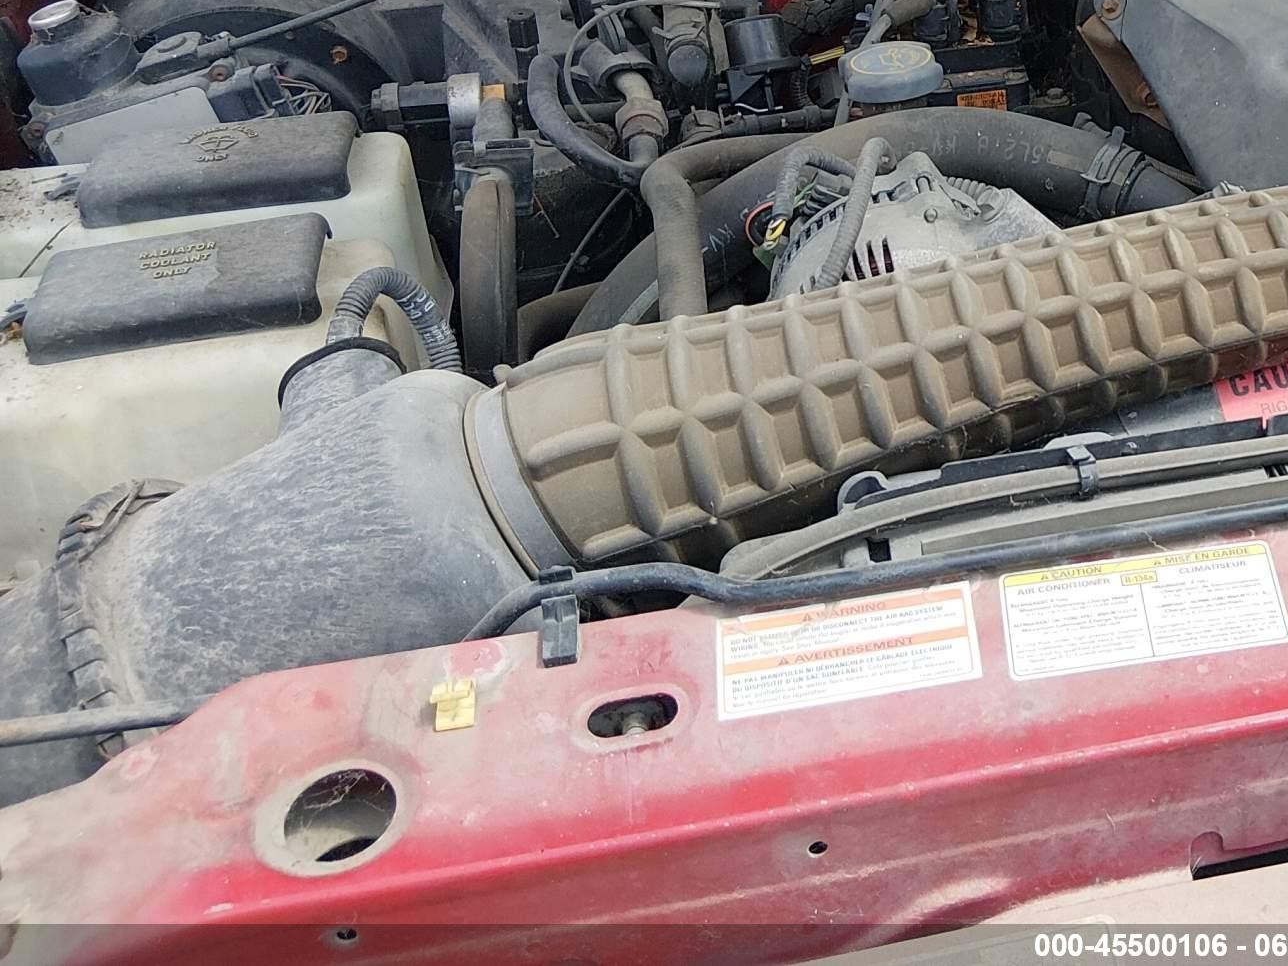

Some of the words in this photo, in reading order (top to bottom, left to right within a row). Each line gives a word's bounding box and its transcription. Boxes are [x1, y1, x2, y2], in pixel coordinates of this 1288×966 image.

[139, 241, 217, 259] RADIATOR
[140, 253, 211, 270] COOLANT
[153, 266, 192, 279] ONLY
[1163, 554, 1193, 565] MISE
[1211, 546, 1250, 558] GARDE
[1050, 565, 1103, 580] CAUTION
[1177, 559, 1247, 575] CLIMATISEUR
[1015, 586, 1036, 597] AIR
[1036, 576, 1111, 594] CONDITIONER
[1123, 573, 1154, 584] R-134a
[815, 598, 887, 620] WARNING
[821, 616, 867, 630] DISCONNECT
[869, 614, 883, 622] THE
[885, 611, 897, 620] AIR
[914, 604, 943, 615] SYSTEM
[793, 634, 914, 665] AVERTISSEMENT
[743, 674, 758, 685] PAS
